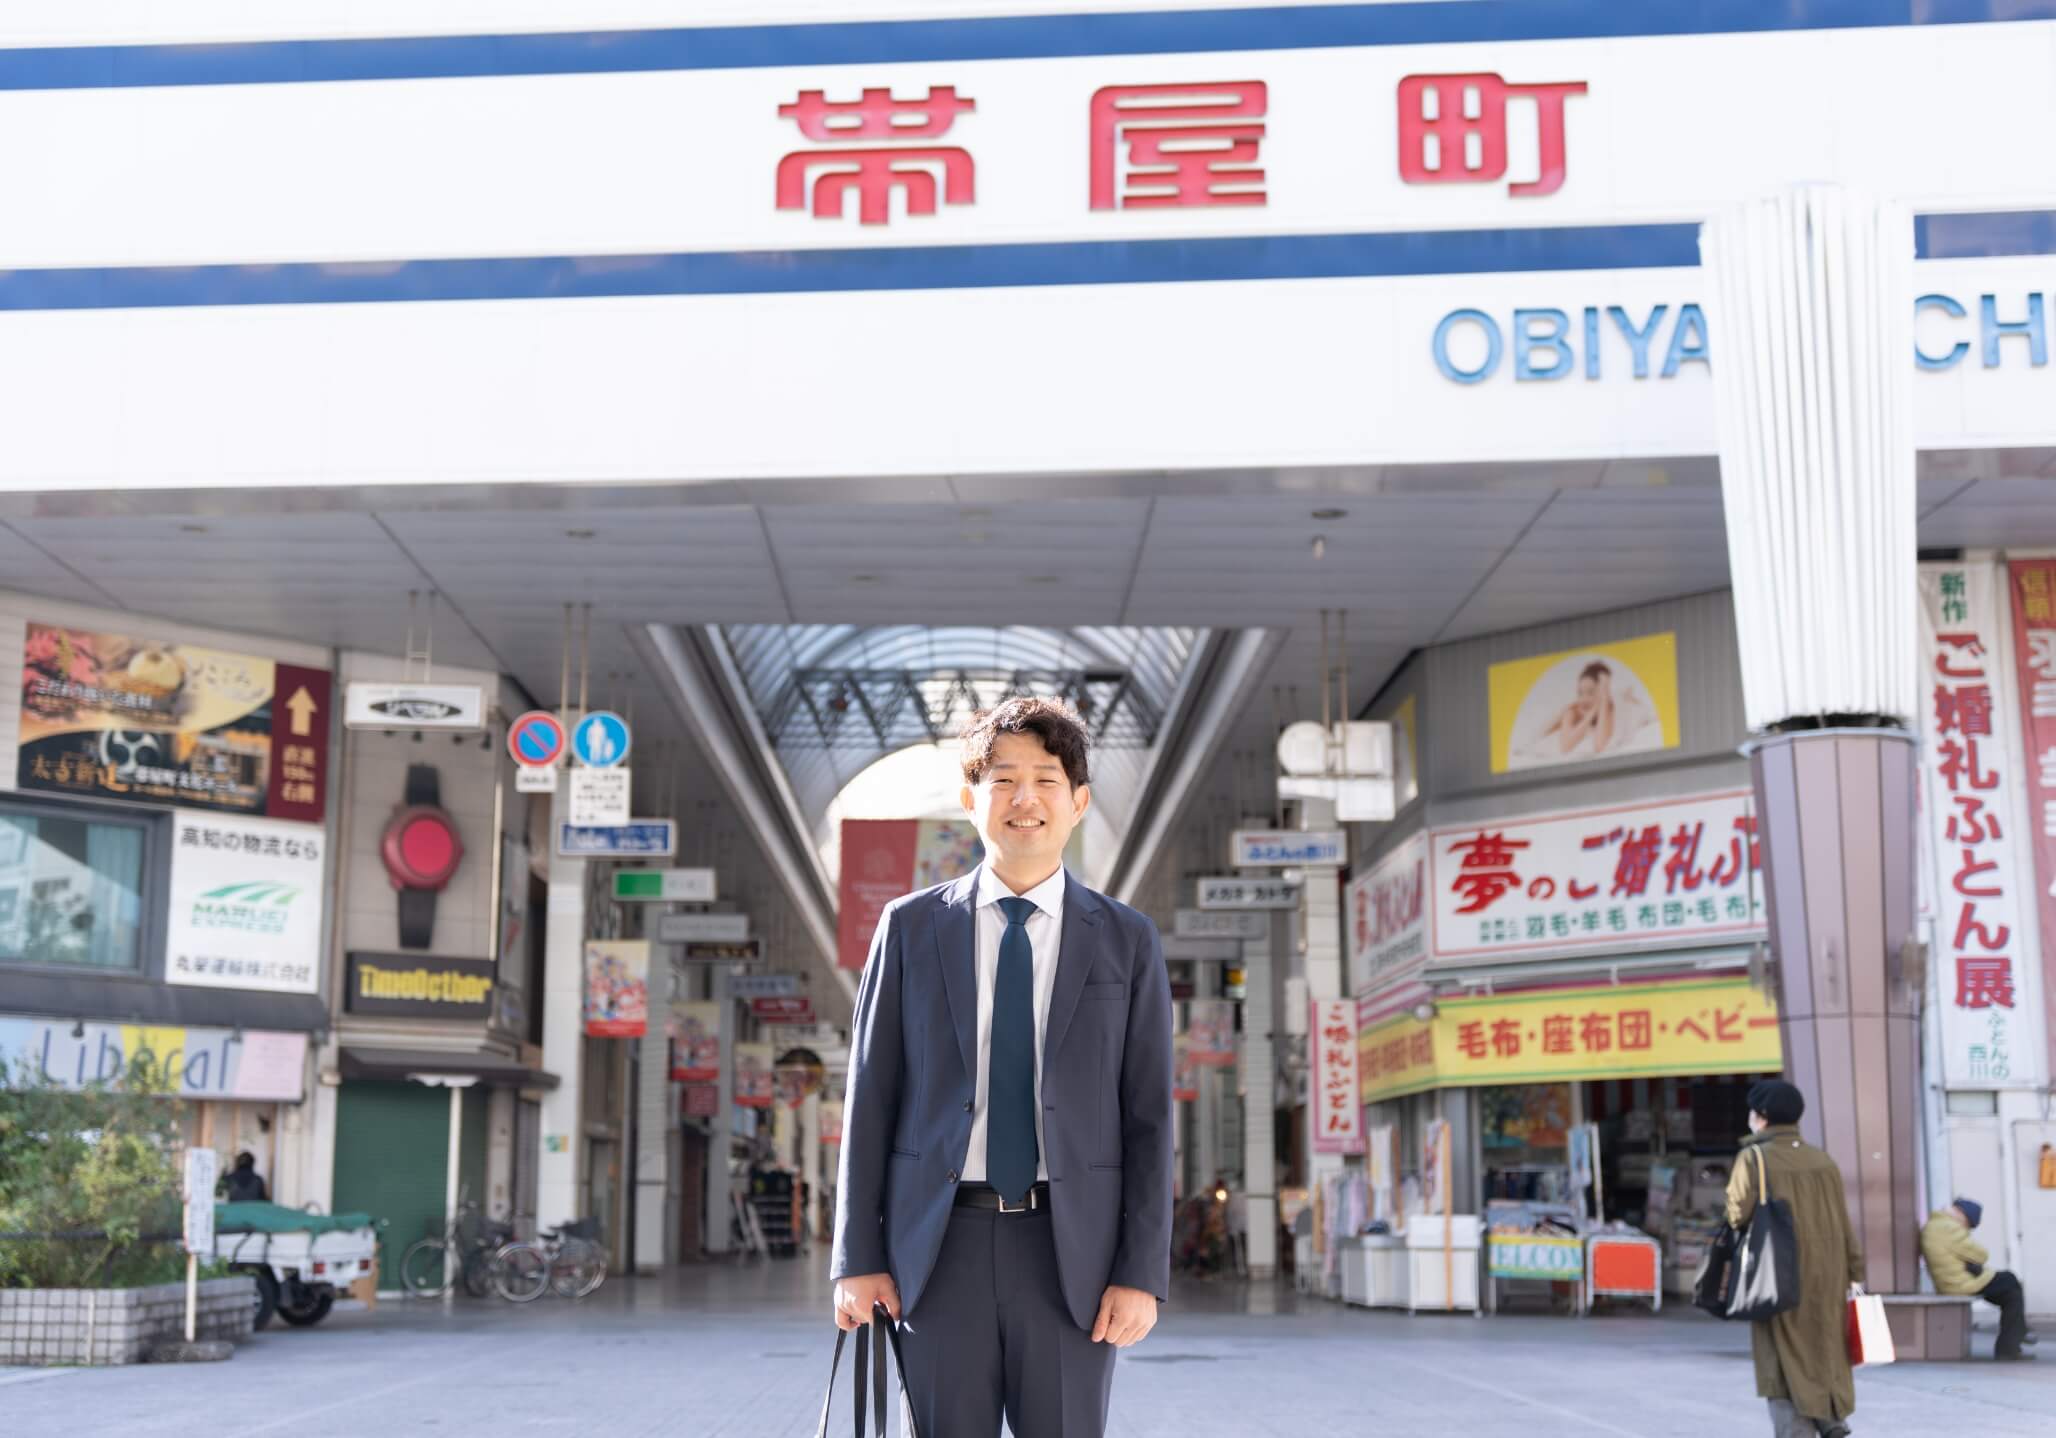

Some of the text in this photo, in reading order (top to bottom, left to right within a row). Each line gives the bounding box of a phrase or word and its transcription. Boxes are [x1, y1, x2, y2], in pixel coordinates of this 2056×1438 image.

[776, 72, 1588, 226] 帯屋町
[1939, 568, 1966, 624] 新作
[181, 826, 319, 860] 高知の物流なら
[1933, 632, 2016, 1010] ご婚礼ふとん展
